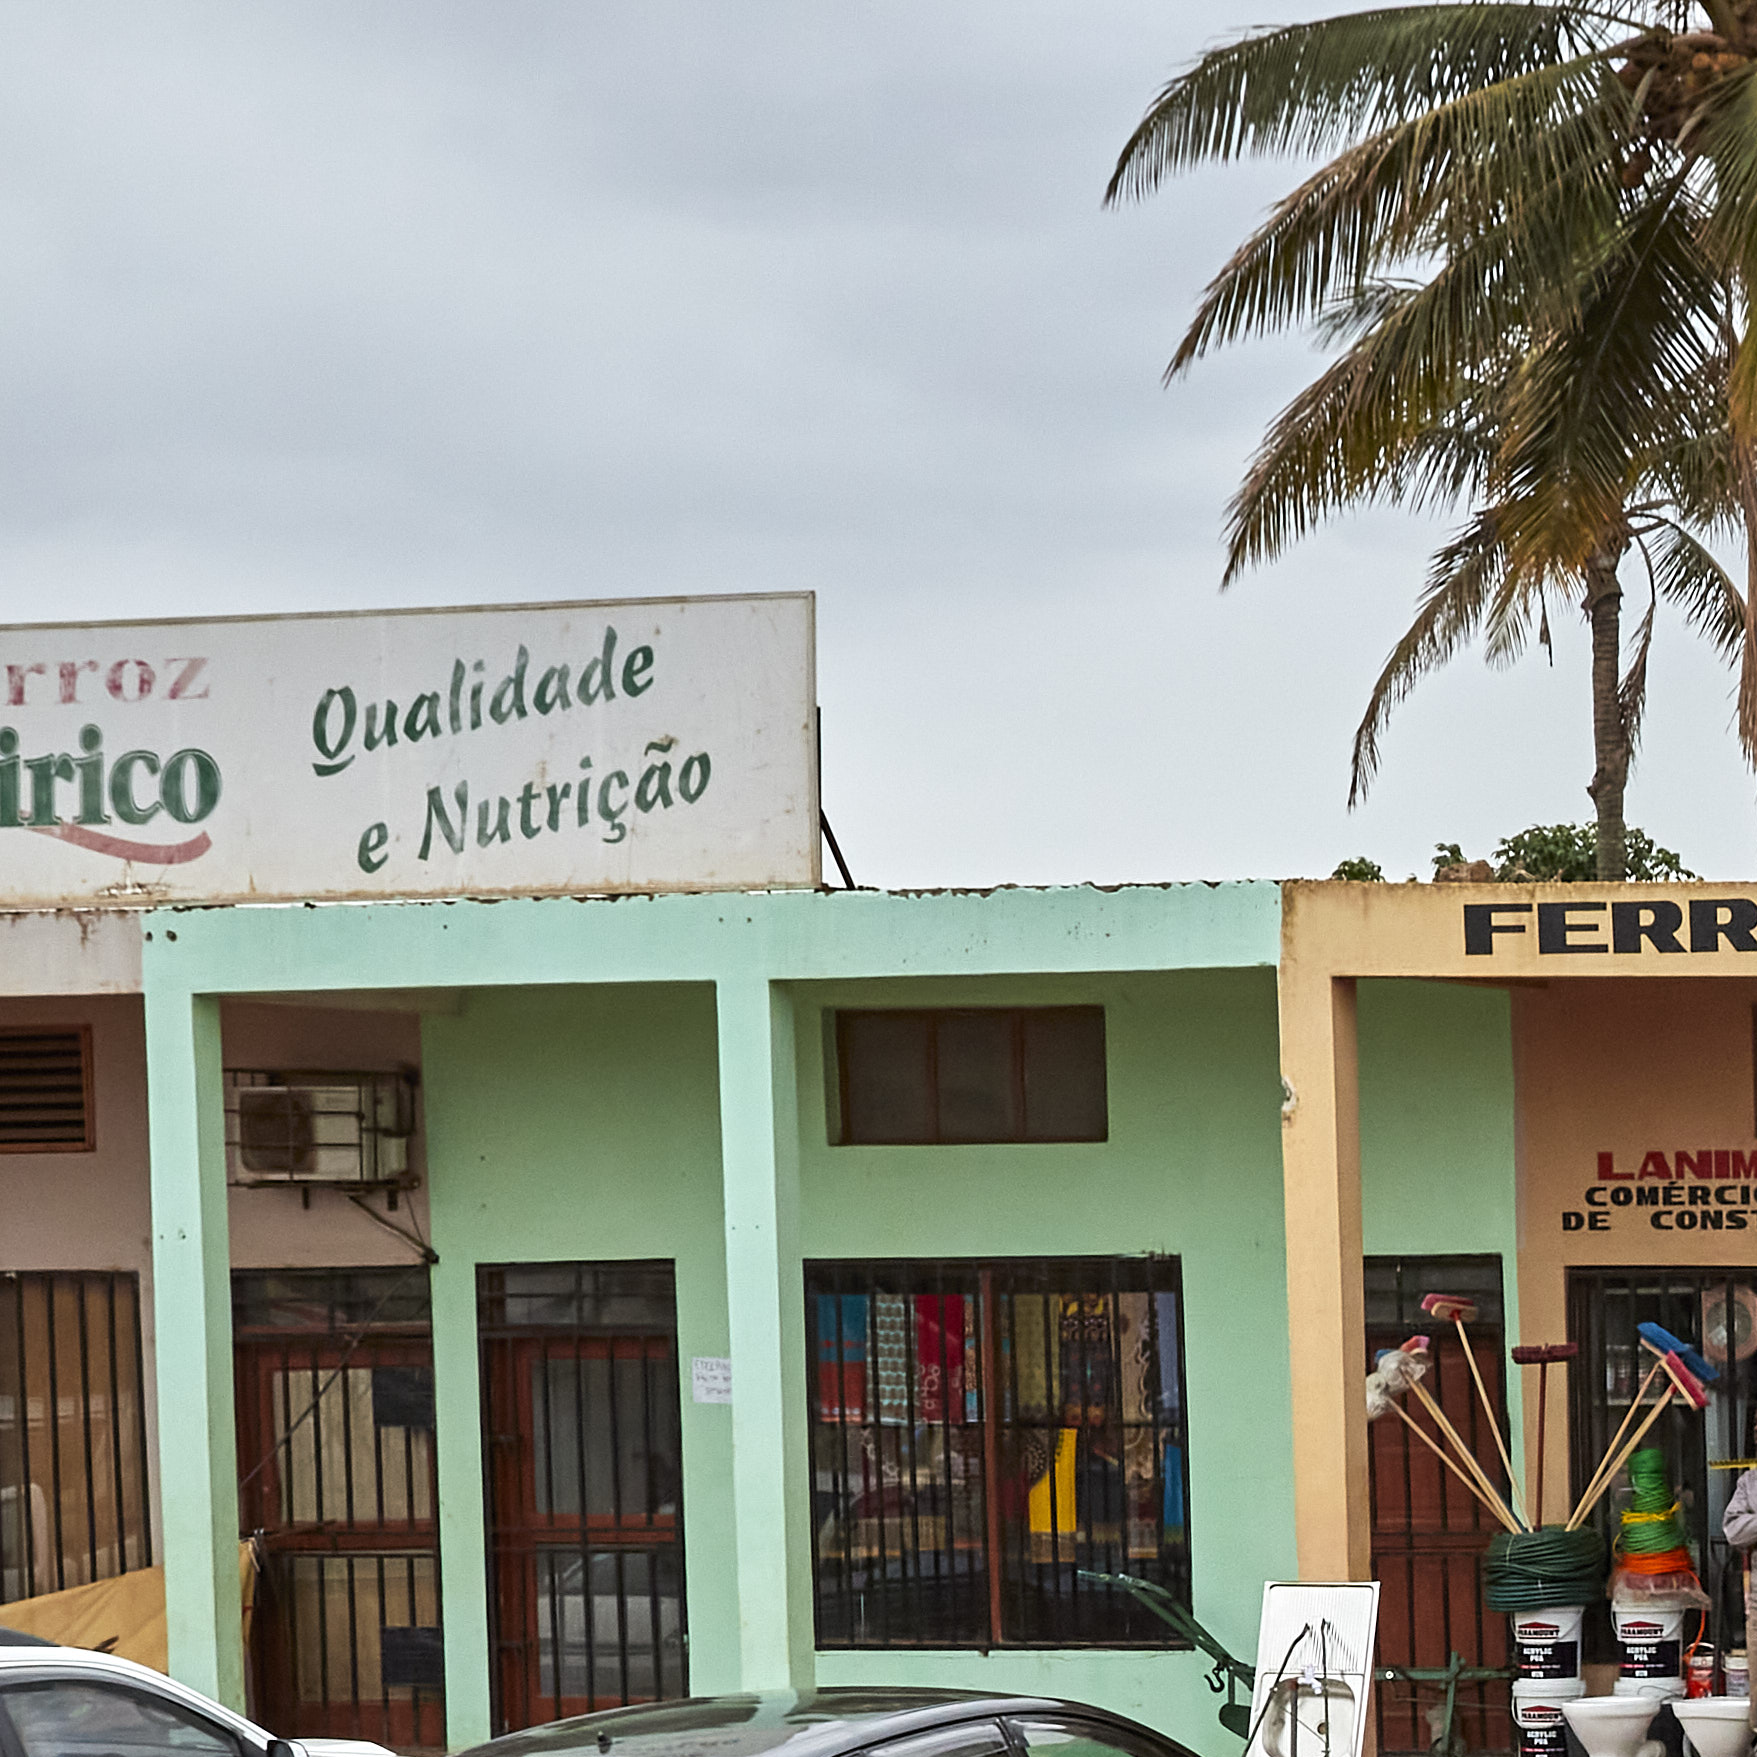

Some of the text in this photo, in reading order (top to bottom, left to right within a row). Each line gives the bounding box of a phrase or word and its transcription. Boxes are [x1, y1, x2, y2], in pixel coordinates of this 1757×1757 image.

[5, 656, 210, 706] rroz
[312, 625, 654, 777] Qualidade
[0, 723, 223, 827] irico
[357, 737, 711, 874] e Nutrição
[1562, 1211, 1611, 1230] DE
